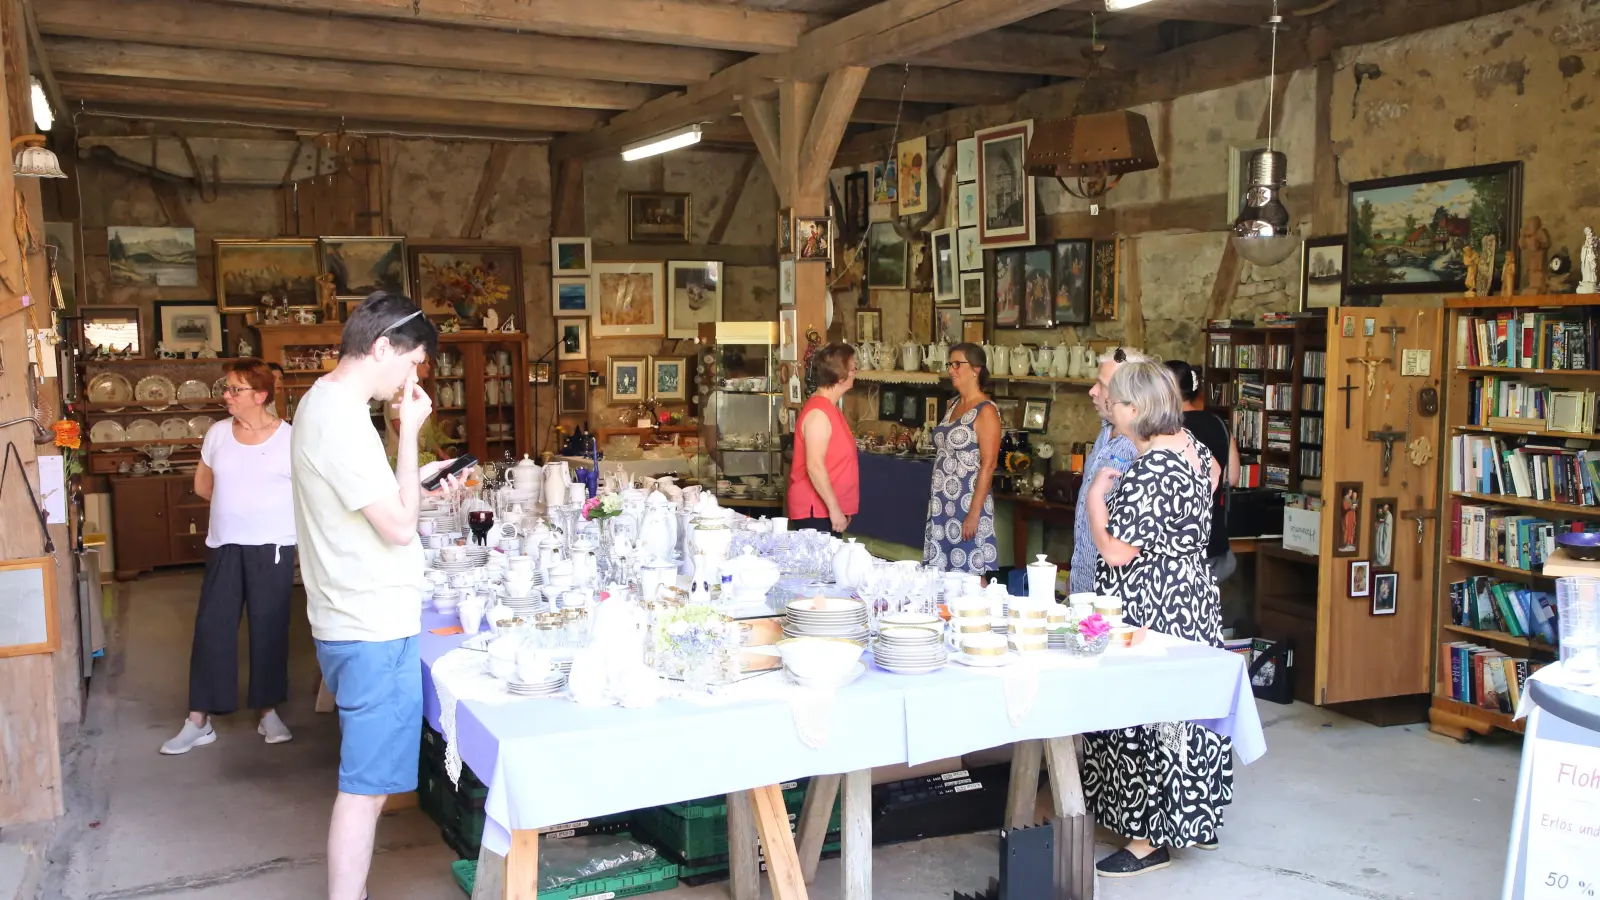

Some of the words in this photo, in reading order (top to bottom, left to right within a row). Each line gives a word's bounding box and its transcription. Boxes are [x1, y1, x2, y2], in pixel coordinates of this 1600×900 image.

[1540, 813, 1573, 832] Erlös
[1545, 871, 1569, 889] 50
[1578, 880, 1595, 897] %
